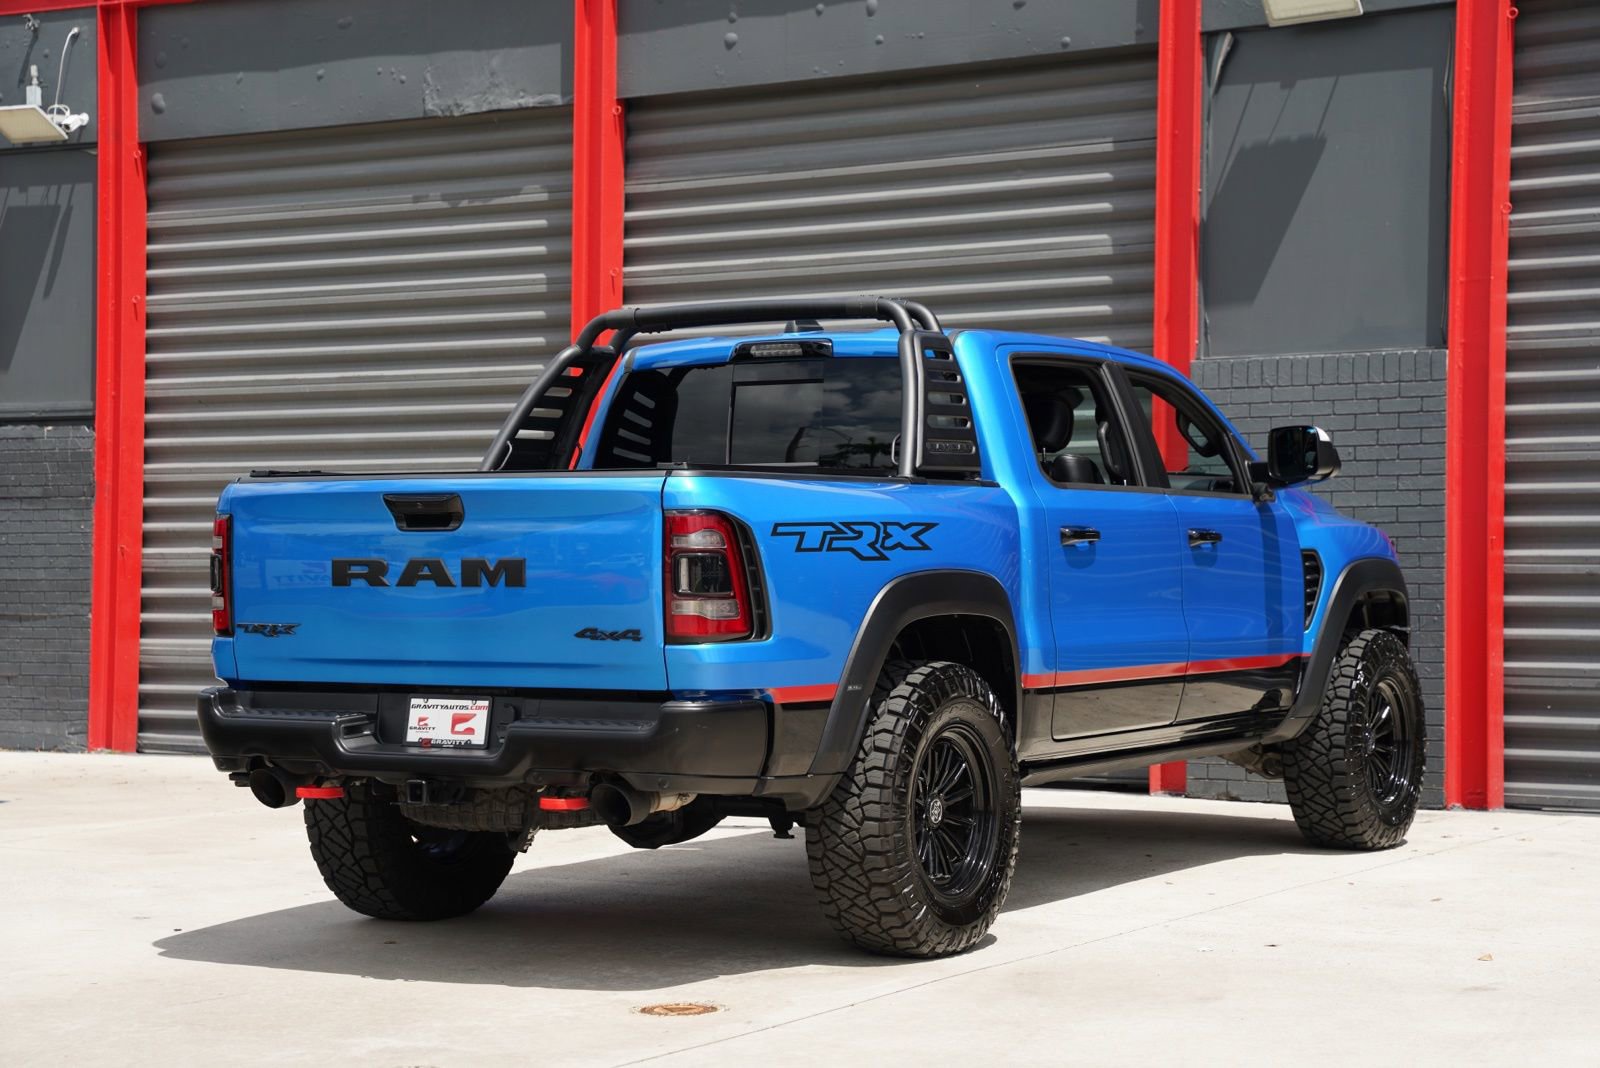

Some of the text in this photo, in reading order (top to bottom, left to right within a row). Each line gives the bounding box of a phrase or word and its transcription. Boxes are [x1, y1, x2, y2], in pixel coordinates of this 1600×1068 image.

[770, 521, 940, 561] TRX
[332, 558, 526, 587] RAM
[237, 623, 301, 636] TRX
[574, 627, 642, 641] 4x4
